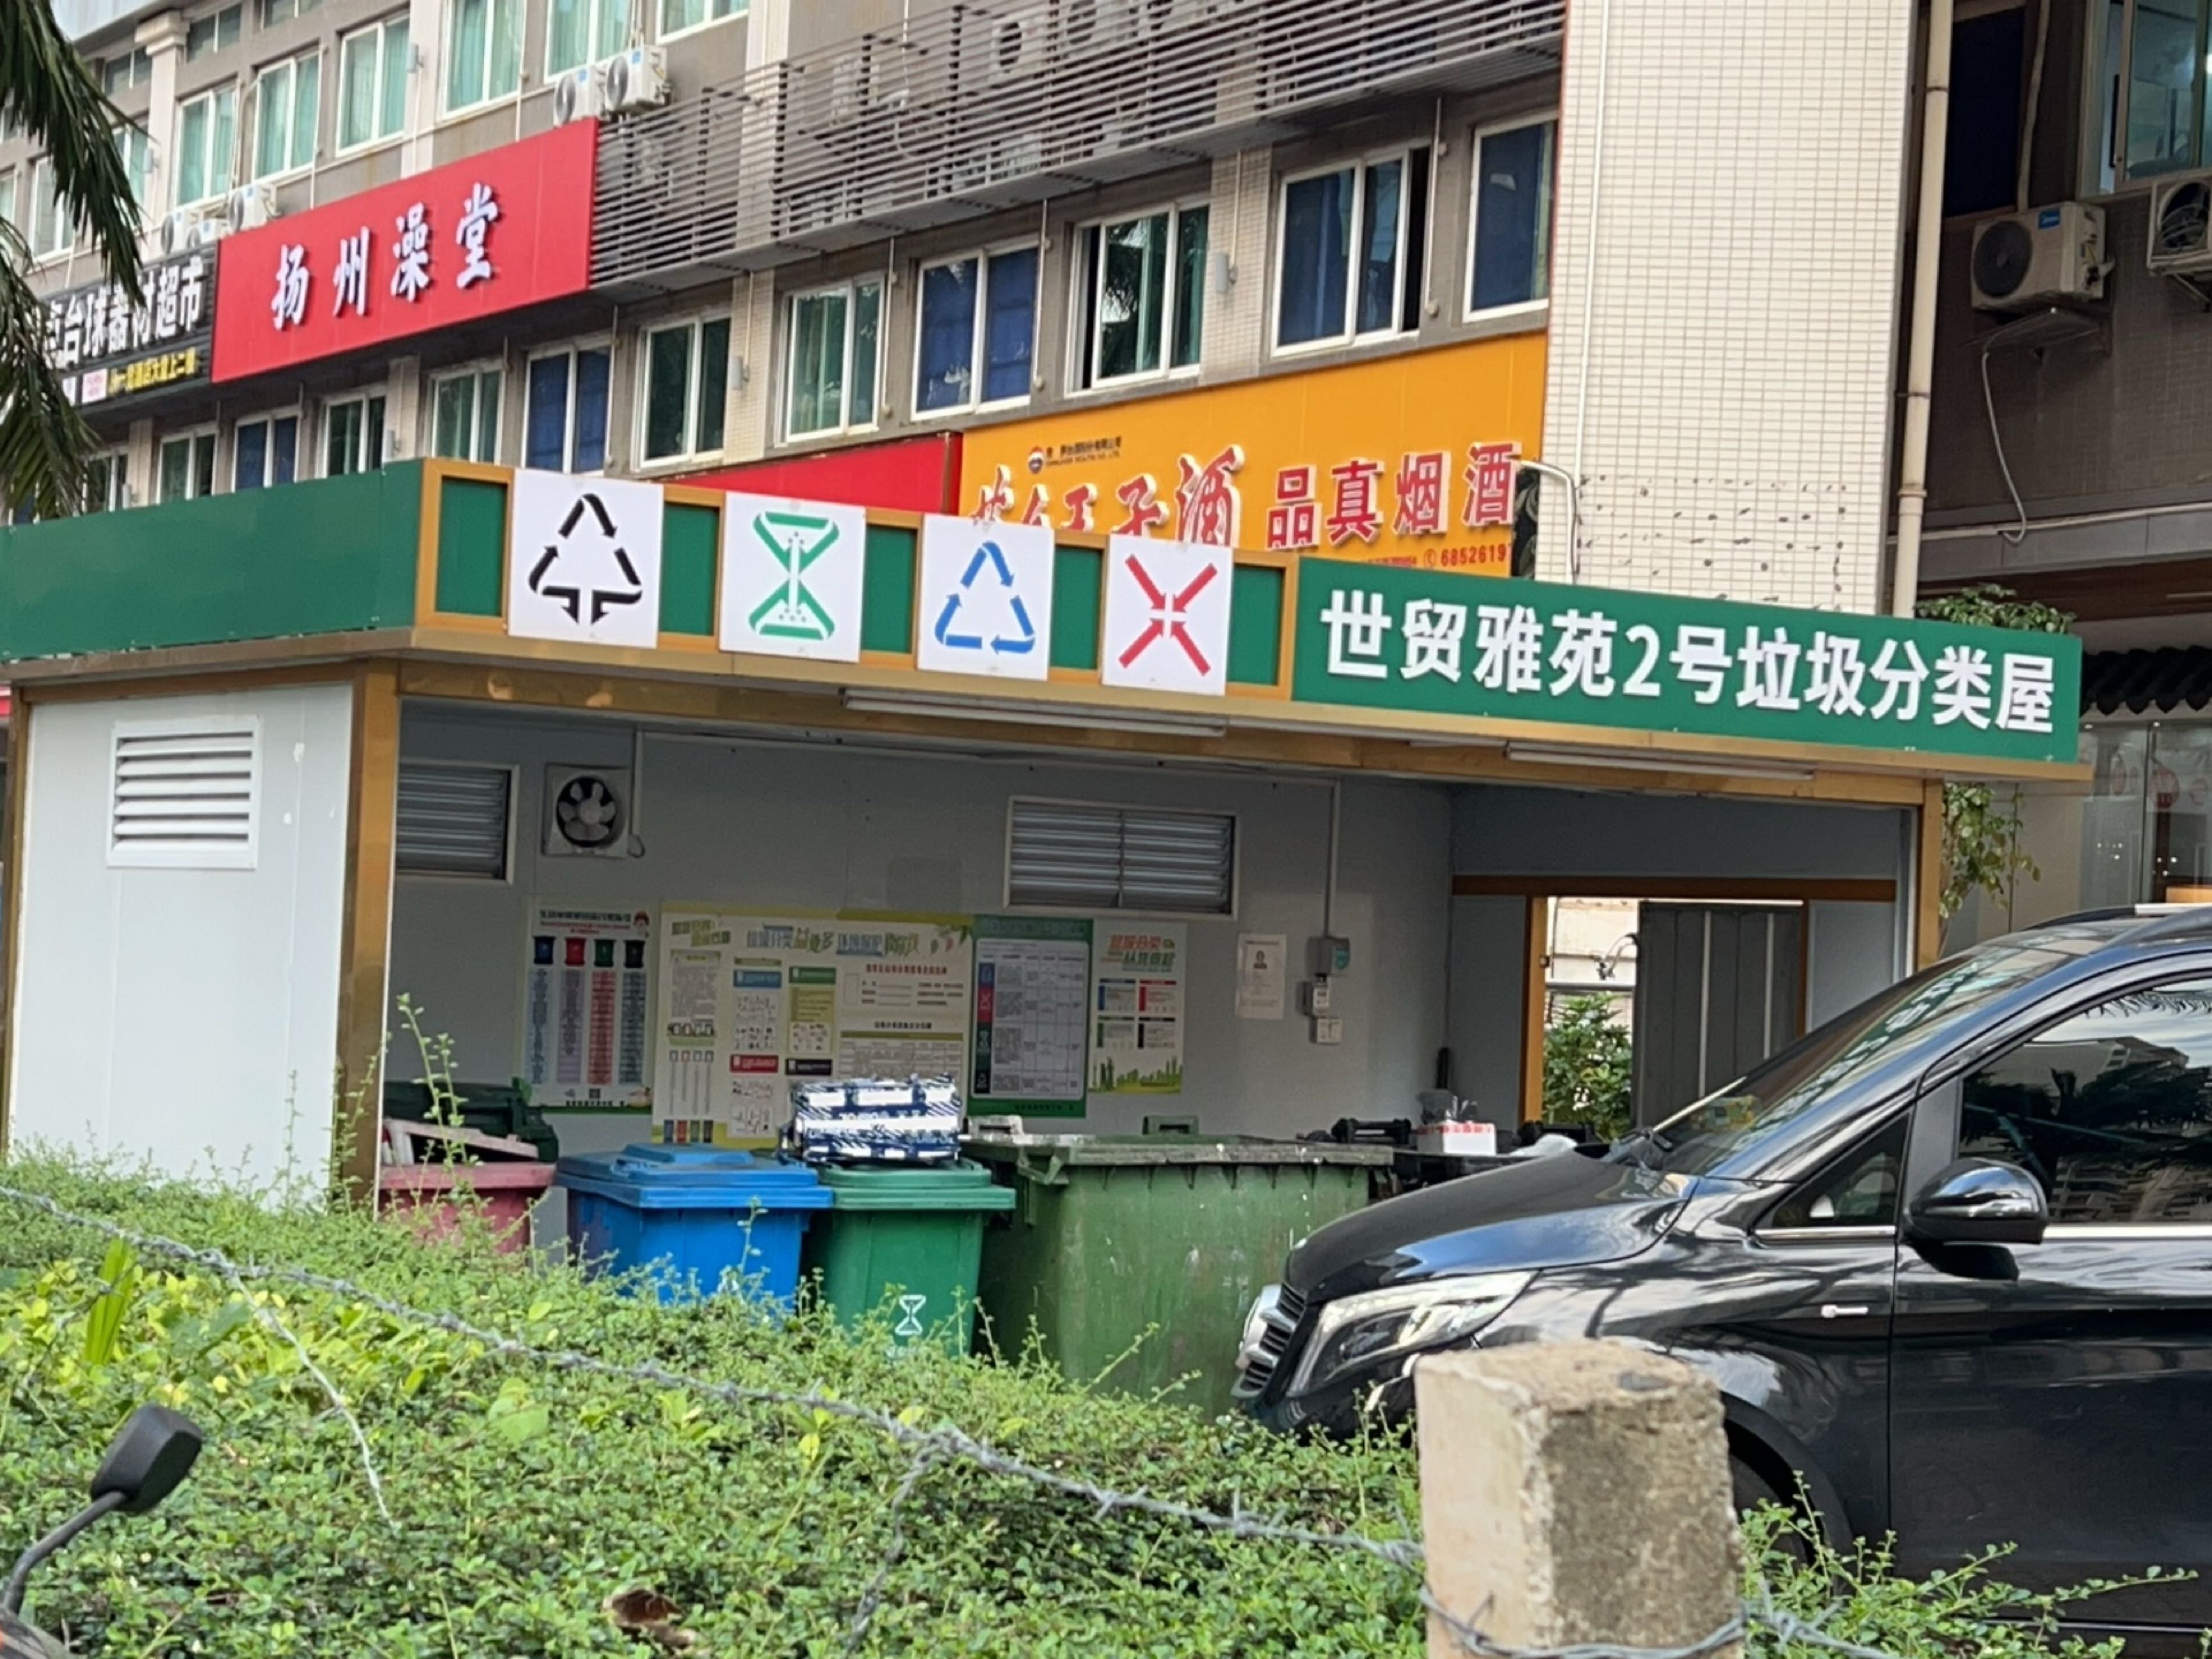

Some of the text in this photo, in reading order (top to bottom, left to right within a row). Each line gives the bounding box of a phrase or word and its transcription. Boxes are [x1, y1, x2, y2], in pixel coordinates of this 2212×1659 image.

[271, 182, 501, 331] 扬州澡堂
[1266, 441, 1521, 550] 品真烟酒
[1441, 543, 1512, 566] 6852619
[1319, 589, 2056, 735] 世贸雅苑2号垃圾分类屋
